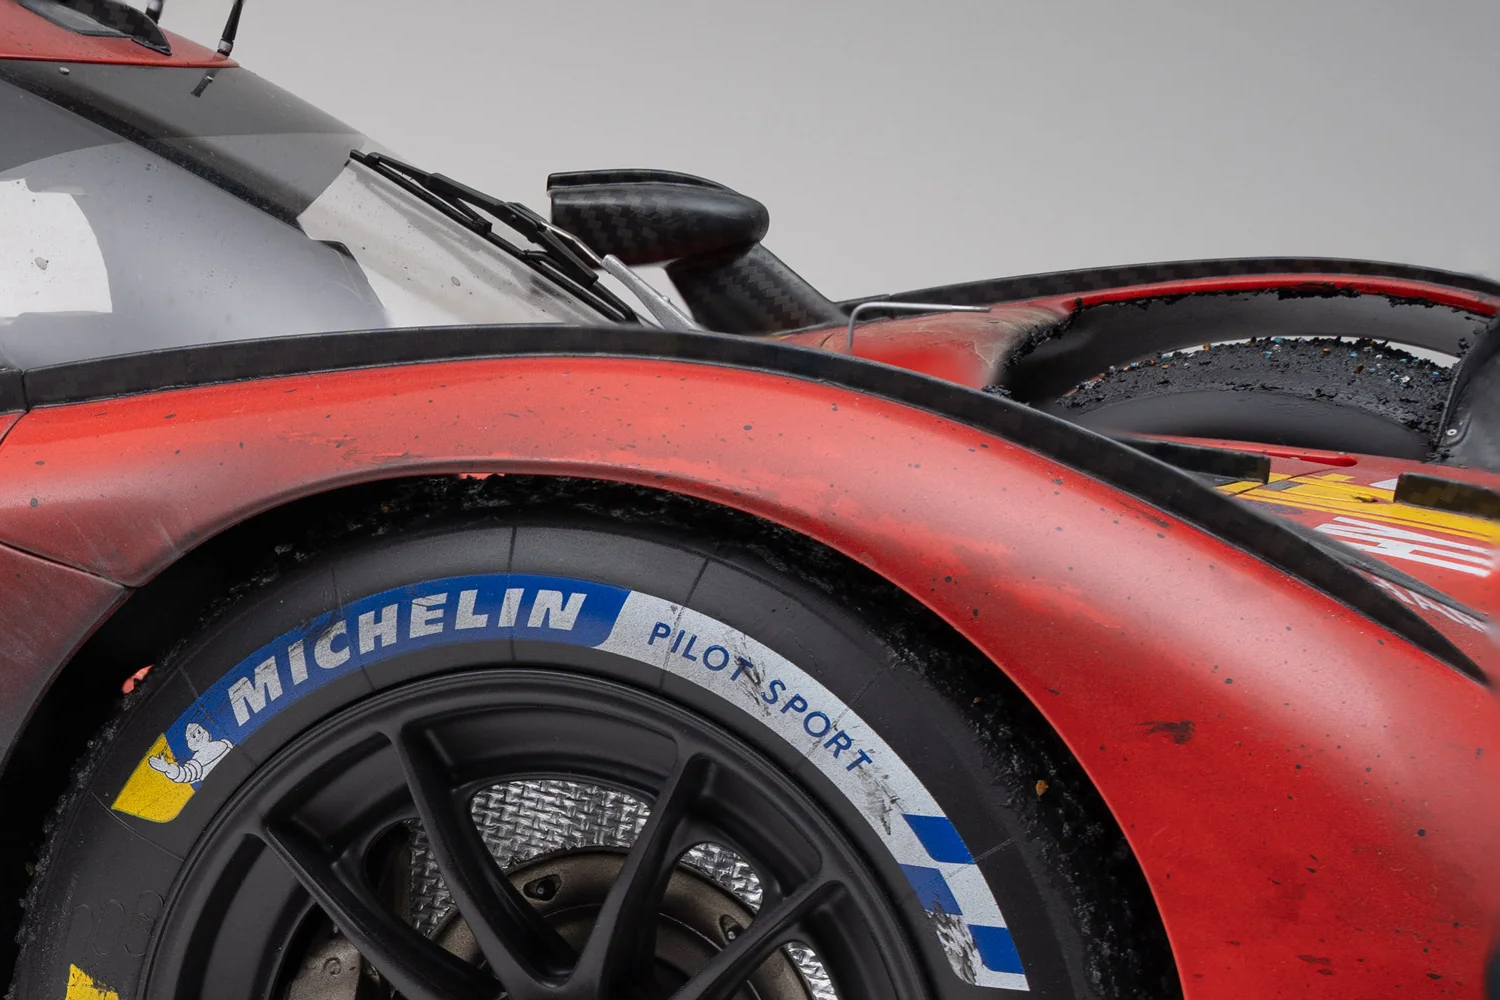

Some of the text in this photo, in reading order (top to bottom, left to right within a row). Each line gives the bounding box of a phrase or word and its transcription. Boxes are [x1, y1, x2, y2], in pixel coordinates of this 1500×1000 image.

[228, 588, 588, 726] MICHELIN
[647, 621, 873, 772] PILOT SPORT
